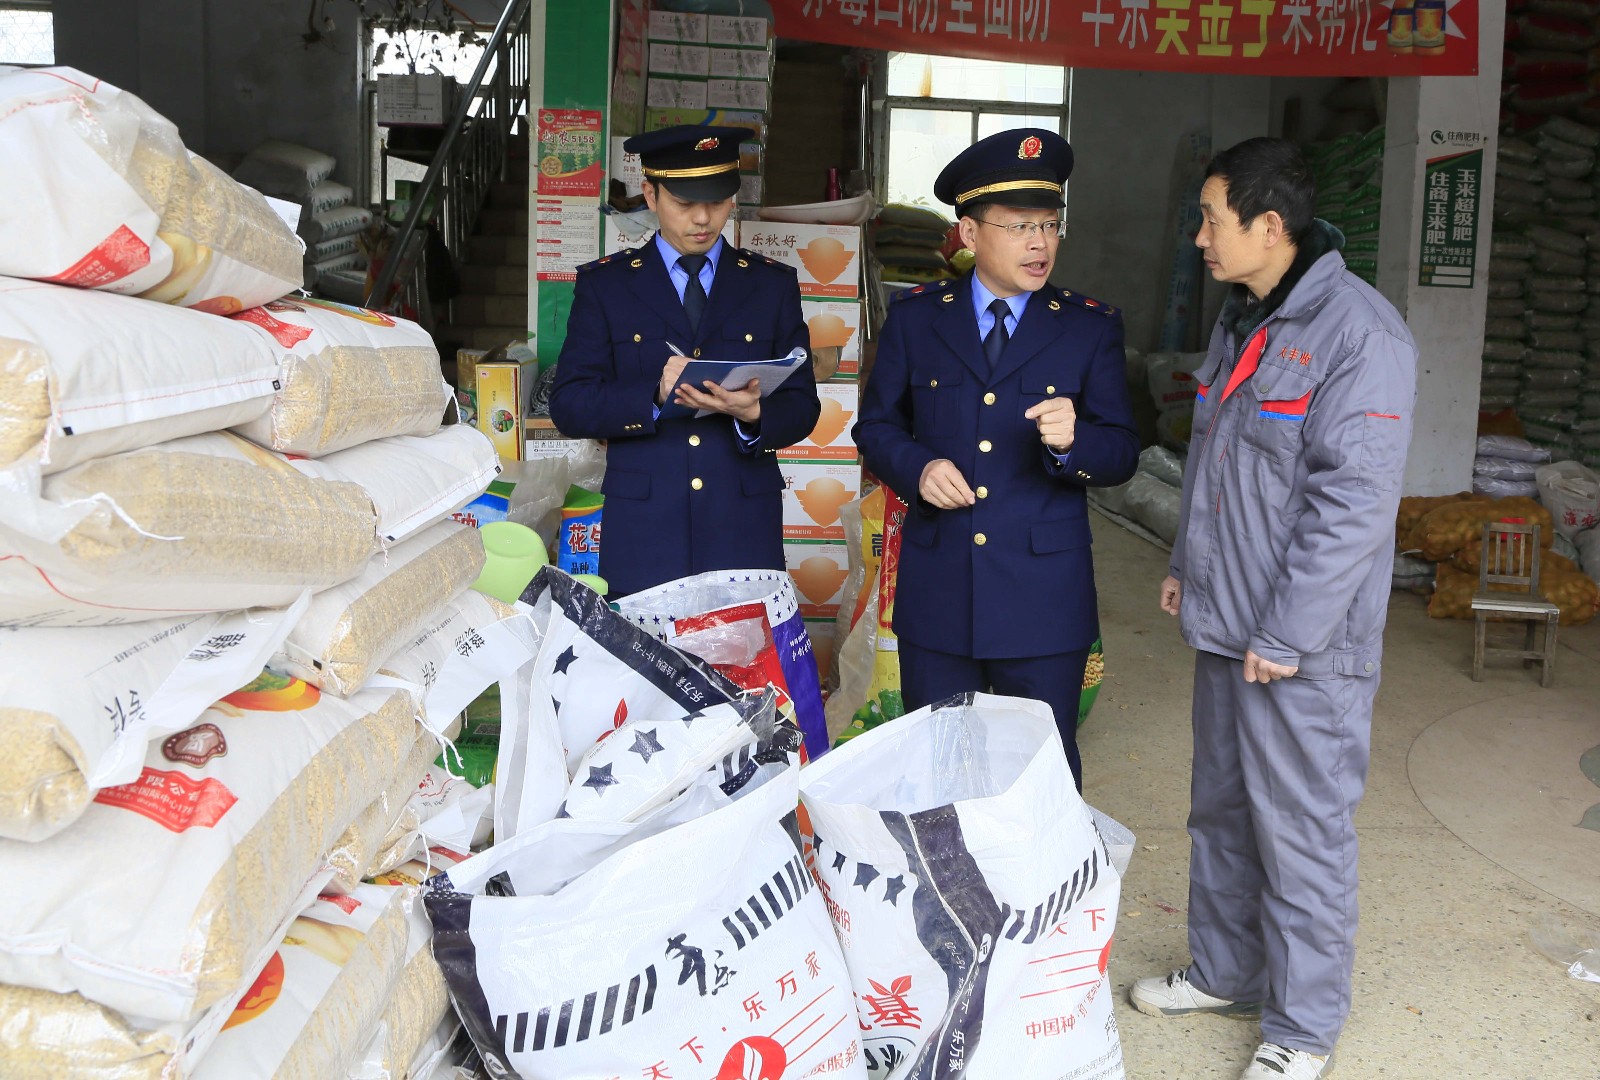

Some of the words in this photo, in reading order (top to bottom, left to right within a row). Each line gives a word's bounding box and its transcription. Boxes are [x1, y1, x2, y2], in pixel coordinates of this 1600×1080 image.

[1447, 131, 1480, 142] 住商肥料
[1426, 171, 1450, 245] 住商玉米肥
[1452, 168, 1476, 241] 玉米超级肥
[751, 233, 797, 248] 乐秋好
[1423, 255, 1473, 265] 省时省工产量高
